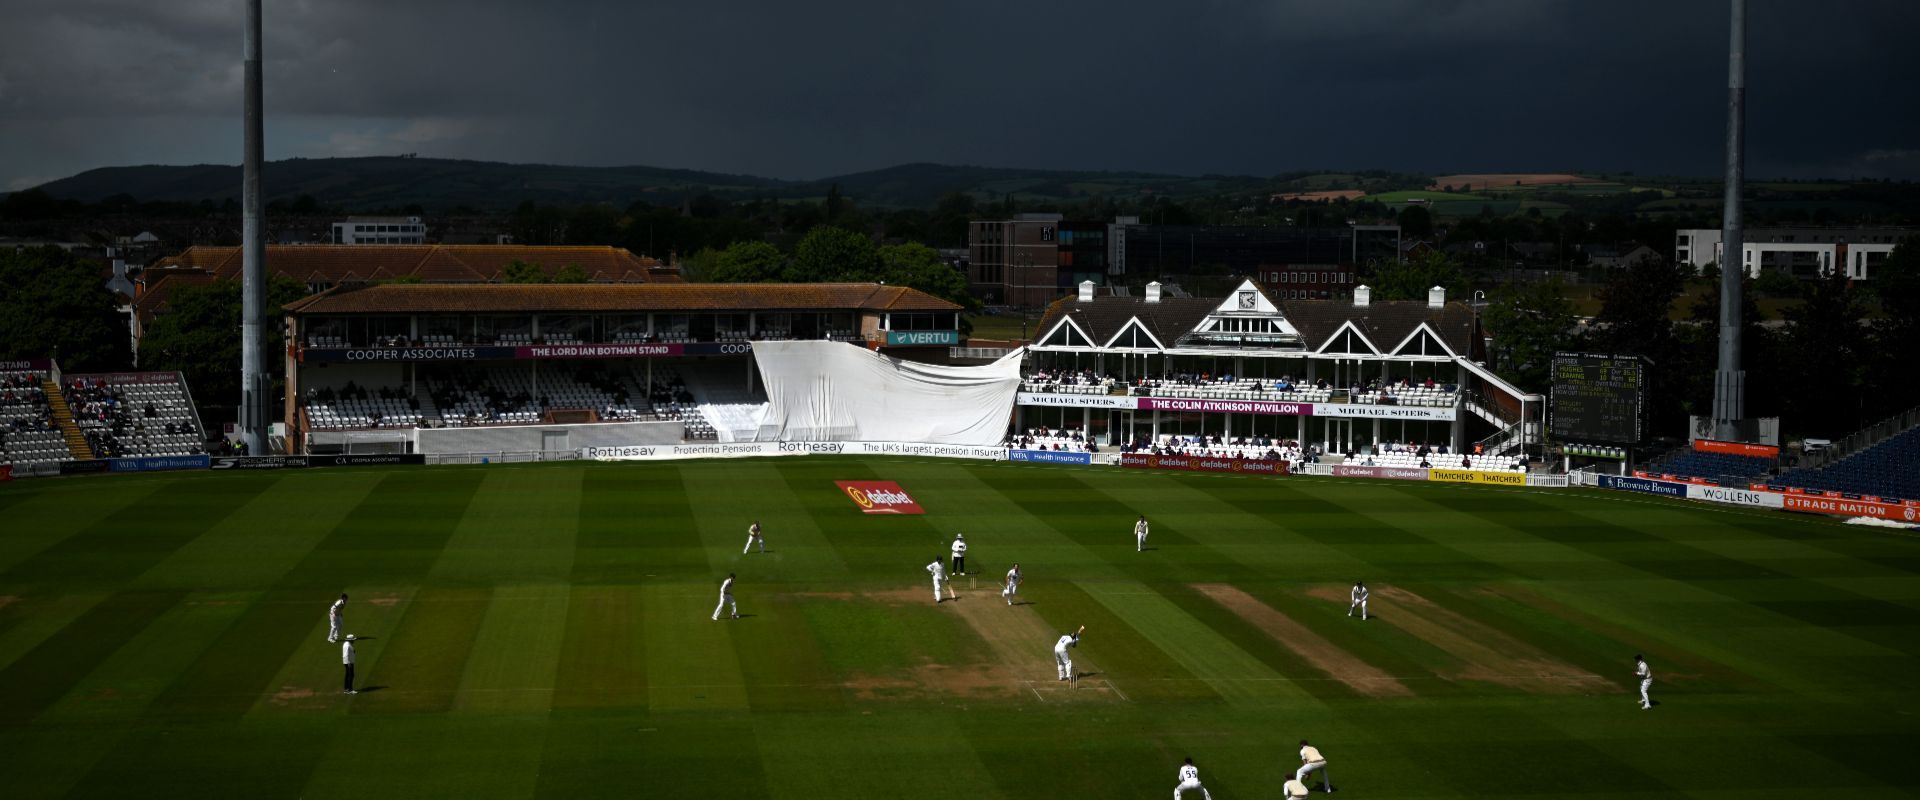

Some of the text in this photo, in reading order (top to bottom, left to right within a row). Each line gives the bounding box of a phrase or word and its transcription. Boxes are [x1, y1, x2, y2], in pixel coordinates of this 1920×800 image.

[909, 333, 949, 343] VERTU
[347, 349, 475, 360] COOPER ASSOCIATES
[532, 346, 668, 357] THE LORD IAN BOTHAM STAND
[720, 344, 752, 354] COOP
[0, 361, 31, 369] STAND
[1032, 397, 1076, 405] MICHAEL
[1079, 398, 1115, 406] SPIERS
[1151, 400, 1299, 413] THE COLIN ATKINSON PAVILION
[1338, 408, 1388, 416] MICHAEL
[1390, 409, 1431, 417] SPIERS
[589, 444, 762, 457] Rothesay Protecting Pensions
[779, 441, 845, 453] Rothesay
[863, 443, 879, 452] The
[882, 443, 900, 452] UK's
[902, 444, 932, 454] largest
[934, 446, 969, 456] pension
[145, 460, 168, 468] Health
[169, 459, 203, 467] Insurance
[1034, 453, 1054, 461] Health
[1055, 455, 1084, 463] Insurance
[1159, 458, 1188, 467] dafabet
[1201, 460, 1231, 469] dafabet
[1243, 462, 1273, 471] dafabet
[1350, 468, 1421, 478] dafabet dafabet
[1434, 472, 1521, 484] THATCHERS THATCHERS
[865, 489, 914, 507] dafabet
[1704, 488, 1760, 504] WOLLENS
[1794, 499, 1886, 515] TRADE NATION
[1185, 770, 1197, 779] 55
